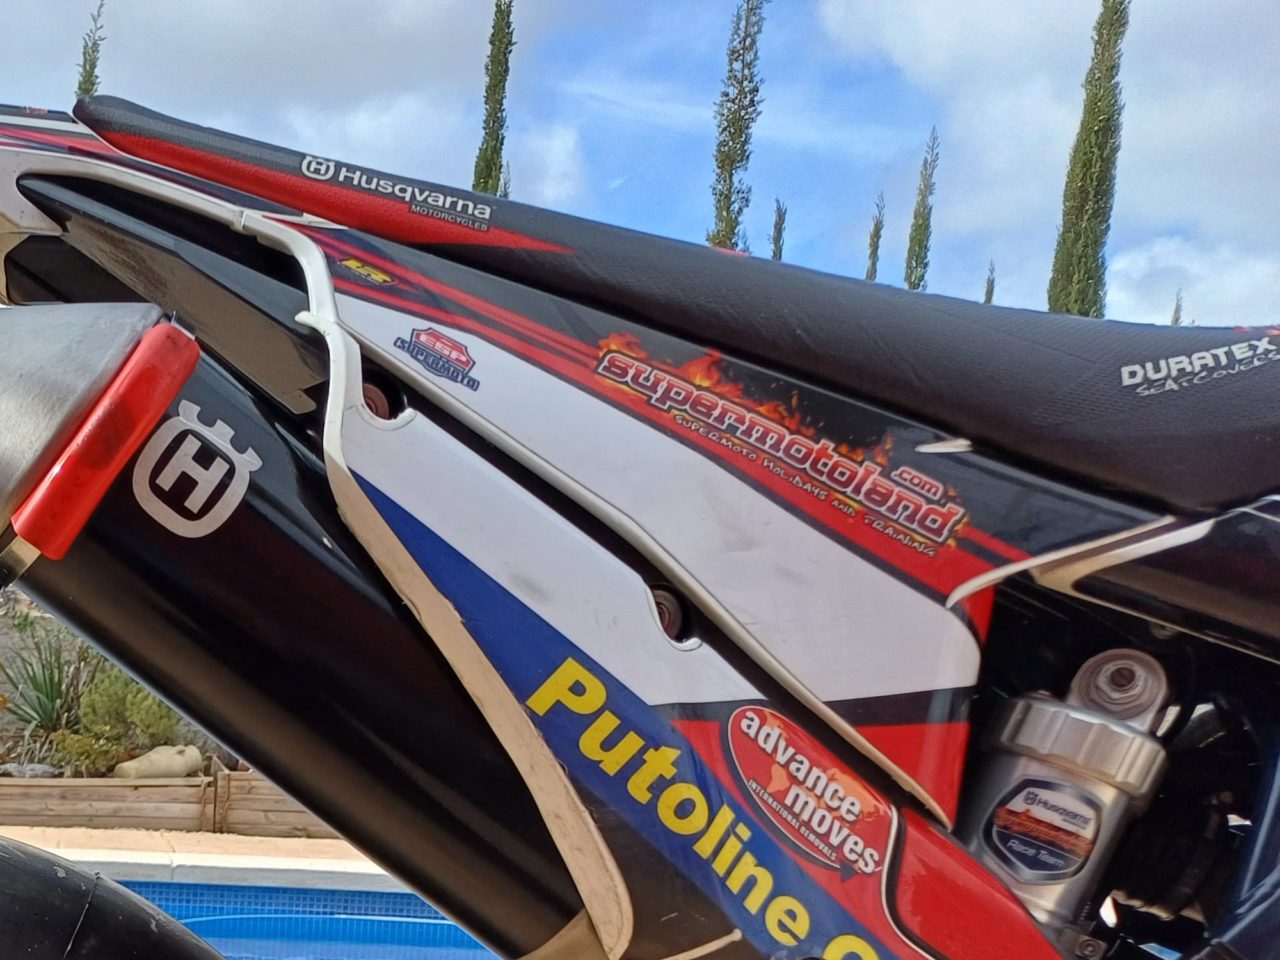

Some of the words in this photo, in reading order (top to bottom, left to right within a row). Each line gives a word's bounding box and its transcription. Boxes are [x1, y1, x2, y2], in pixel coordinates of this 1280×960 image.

[338, 167, 490, 219] Husqvarna
[410, 205, 488, 231] MOTORCYCLES
[1121, 336, 1277, 387] DURATEX
[596, 348, 964, 543] supermotoland
[675, 413, 757, 461] SUPERMOTO
[831, 499, 856, 517] AND
[890, 465, 945, 500] .com
[739, 709, 863, 825] advance
[525, 656, 811, 947] Putoline
[748, 778, 801, 830] INTERNATIONAL
[799, 825, 837, 862] REMOVALS
[783, 783, 881, 875] moves
[1036, 798, 1092, 825] Husqvarna
[1006, 839, 1037, 857] Race
[1037, 849, 1065, 868] Team
